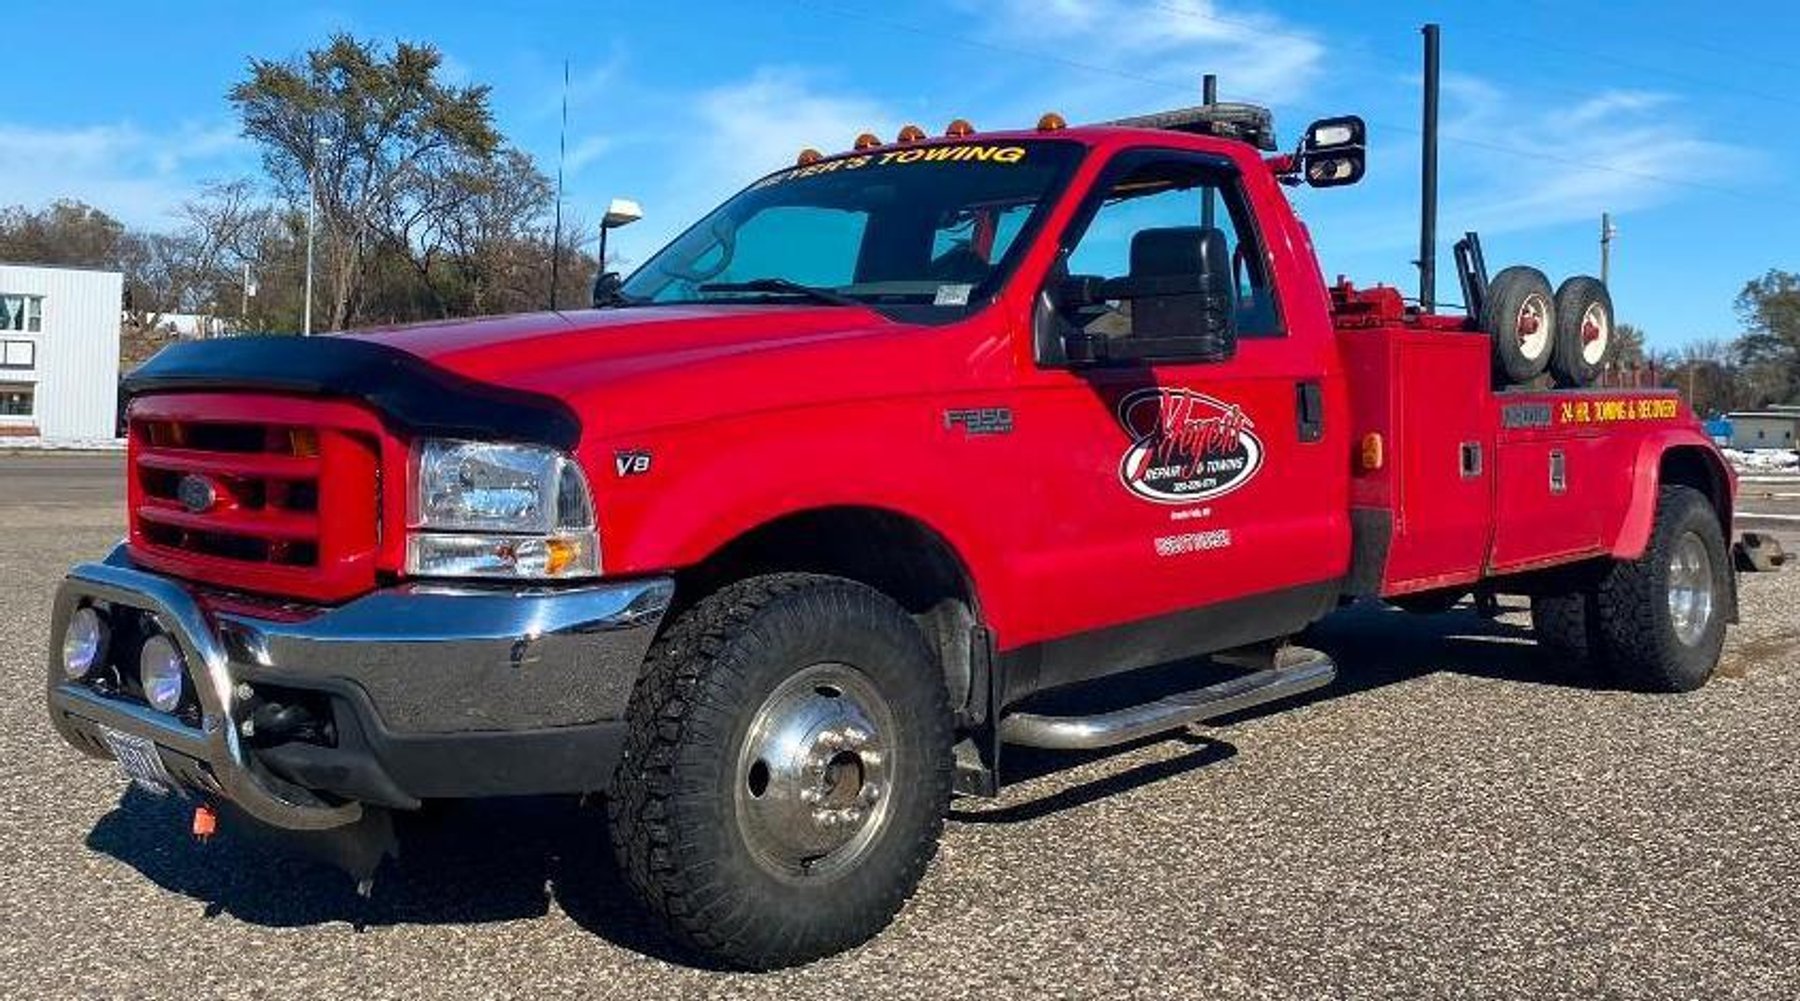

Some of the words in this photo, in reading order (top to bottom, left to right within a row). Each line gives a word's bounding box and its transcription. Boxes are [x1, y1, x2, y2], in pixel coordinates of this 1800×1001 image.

[879, 146, 1026, 165] TOWING
[943, 407, 1013, 430] F350
[1561, 401, 1574, 423] 24
[1594, 401, 1627, 421] TOWING
[1638, 399, 1678, 419] RECOVERY
[616, 453, 650, 477] V8
[1144, 465, 1181, 481] REPAIR
